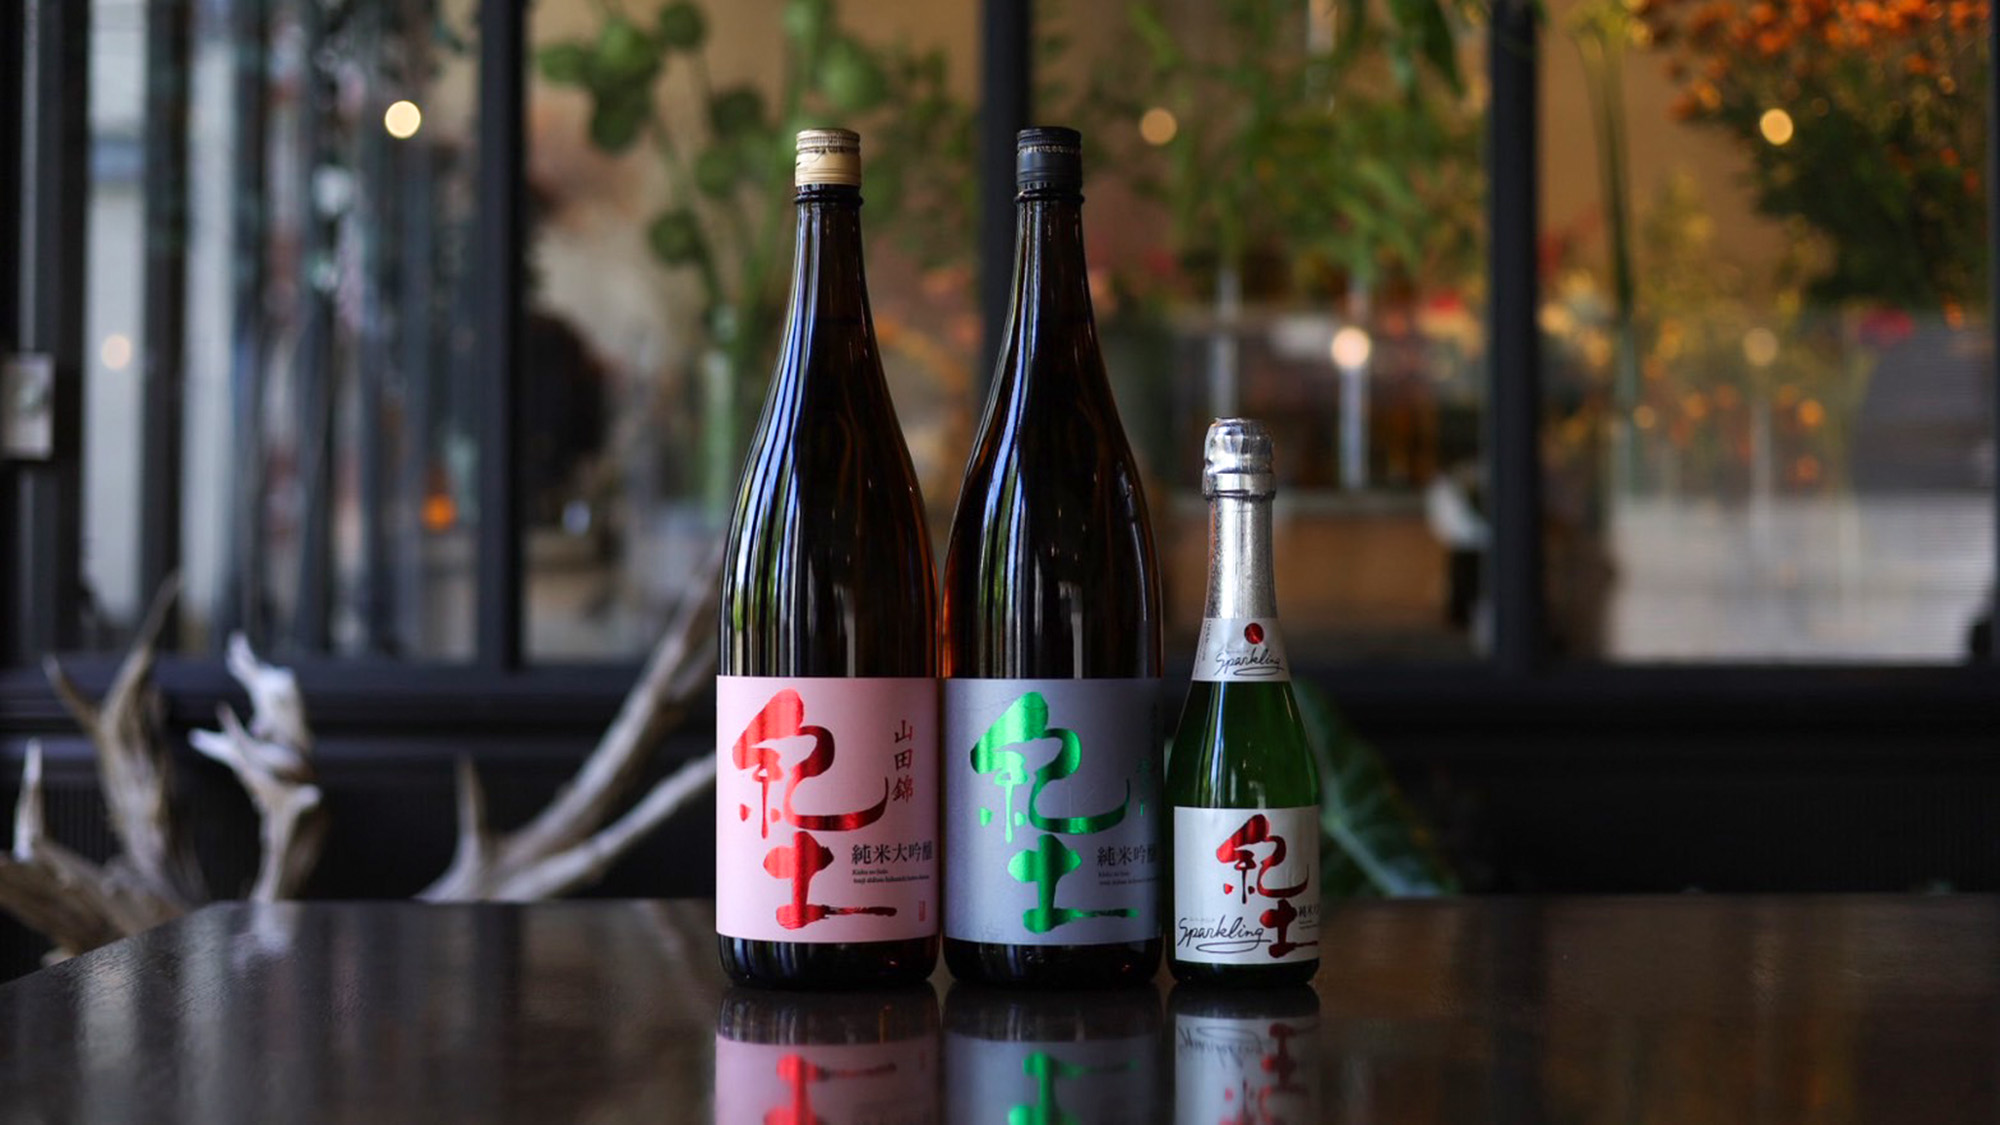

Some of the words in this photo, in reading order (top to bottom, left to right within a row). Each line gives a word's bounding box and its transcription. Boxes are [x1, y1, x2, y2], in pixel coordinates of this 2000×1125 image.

[1214, 647, 1284, 676] Sparkling
[891, 719, 914, 804] 山田錦
[1177, 914, 1272, 954] Sparkling
